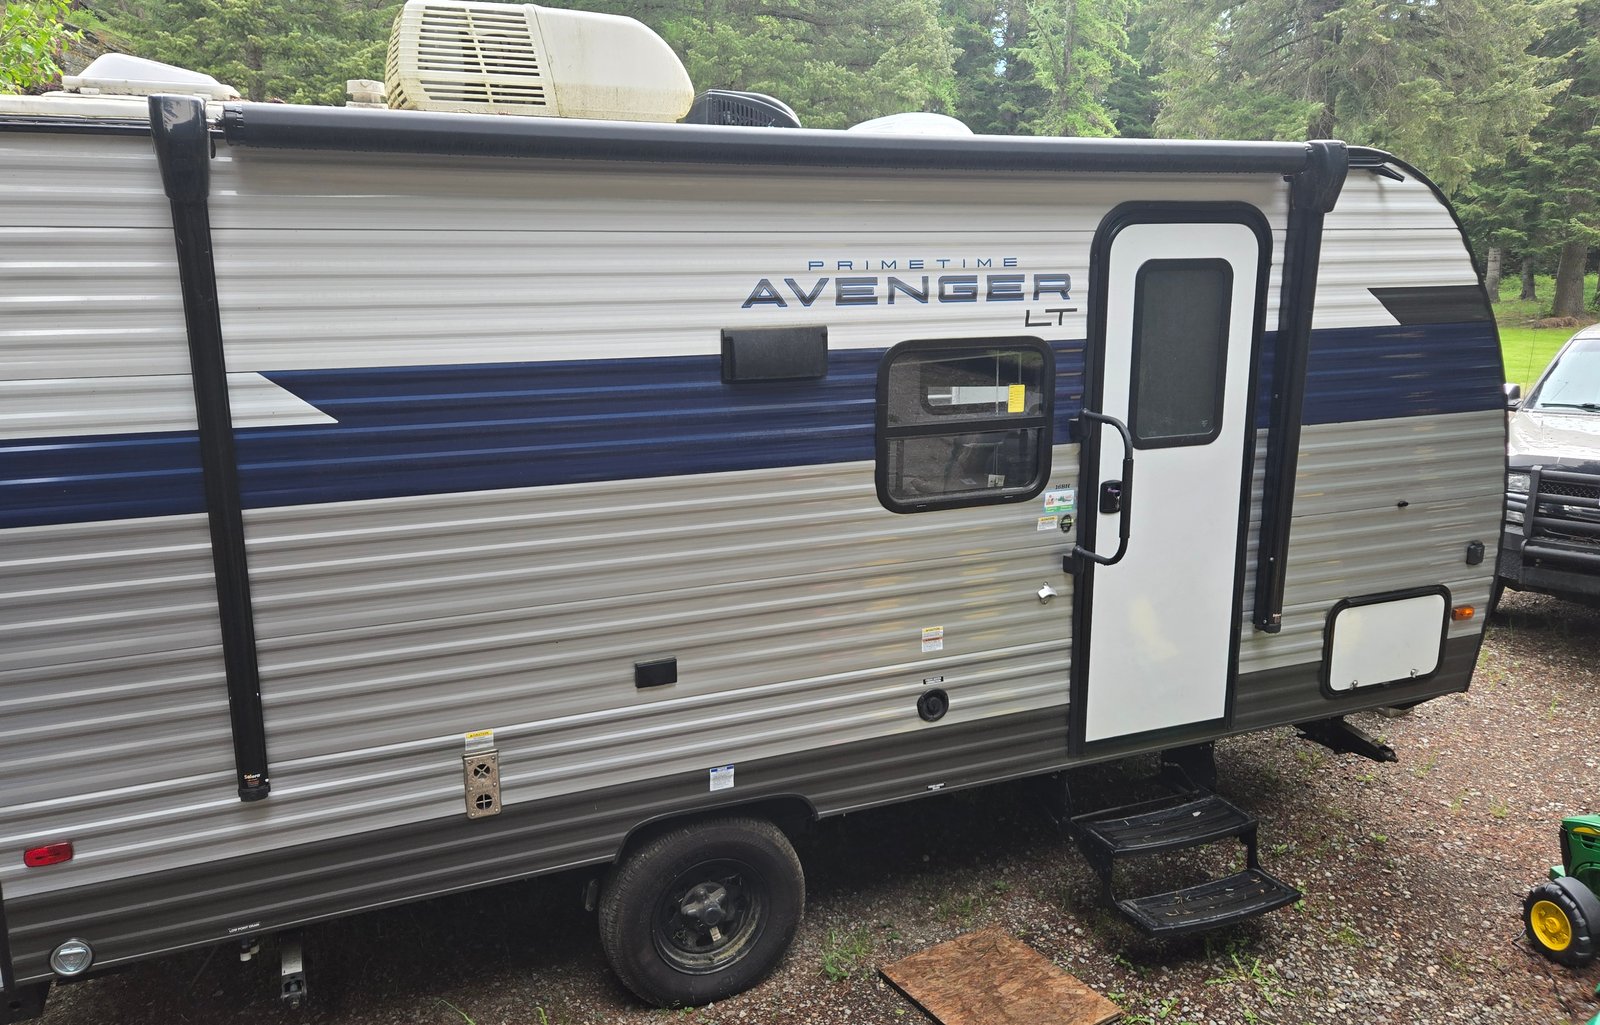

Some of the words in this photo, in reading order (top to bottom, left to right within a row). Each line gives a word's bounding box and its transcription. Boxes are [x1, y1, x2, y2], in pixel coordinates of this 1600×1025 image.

[808, 257, 1018, 271] PRIMETIME
[741, 273, 1072, 308] AVENGER
[1024, 308, 1078, 327] LT
